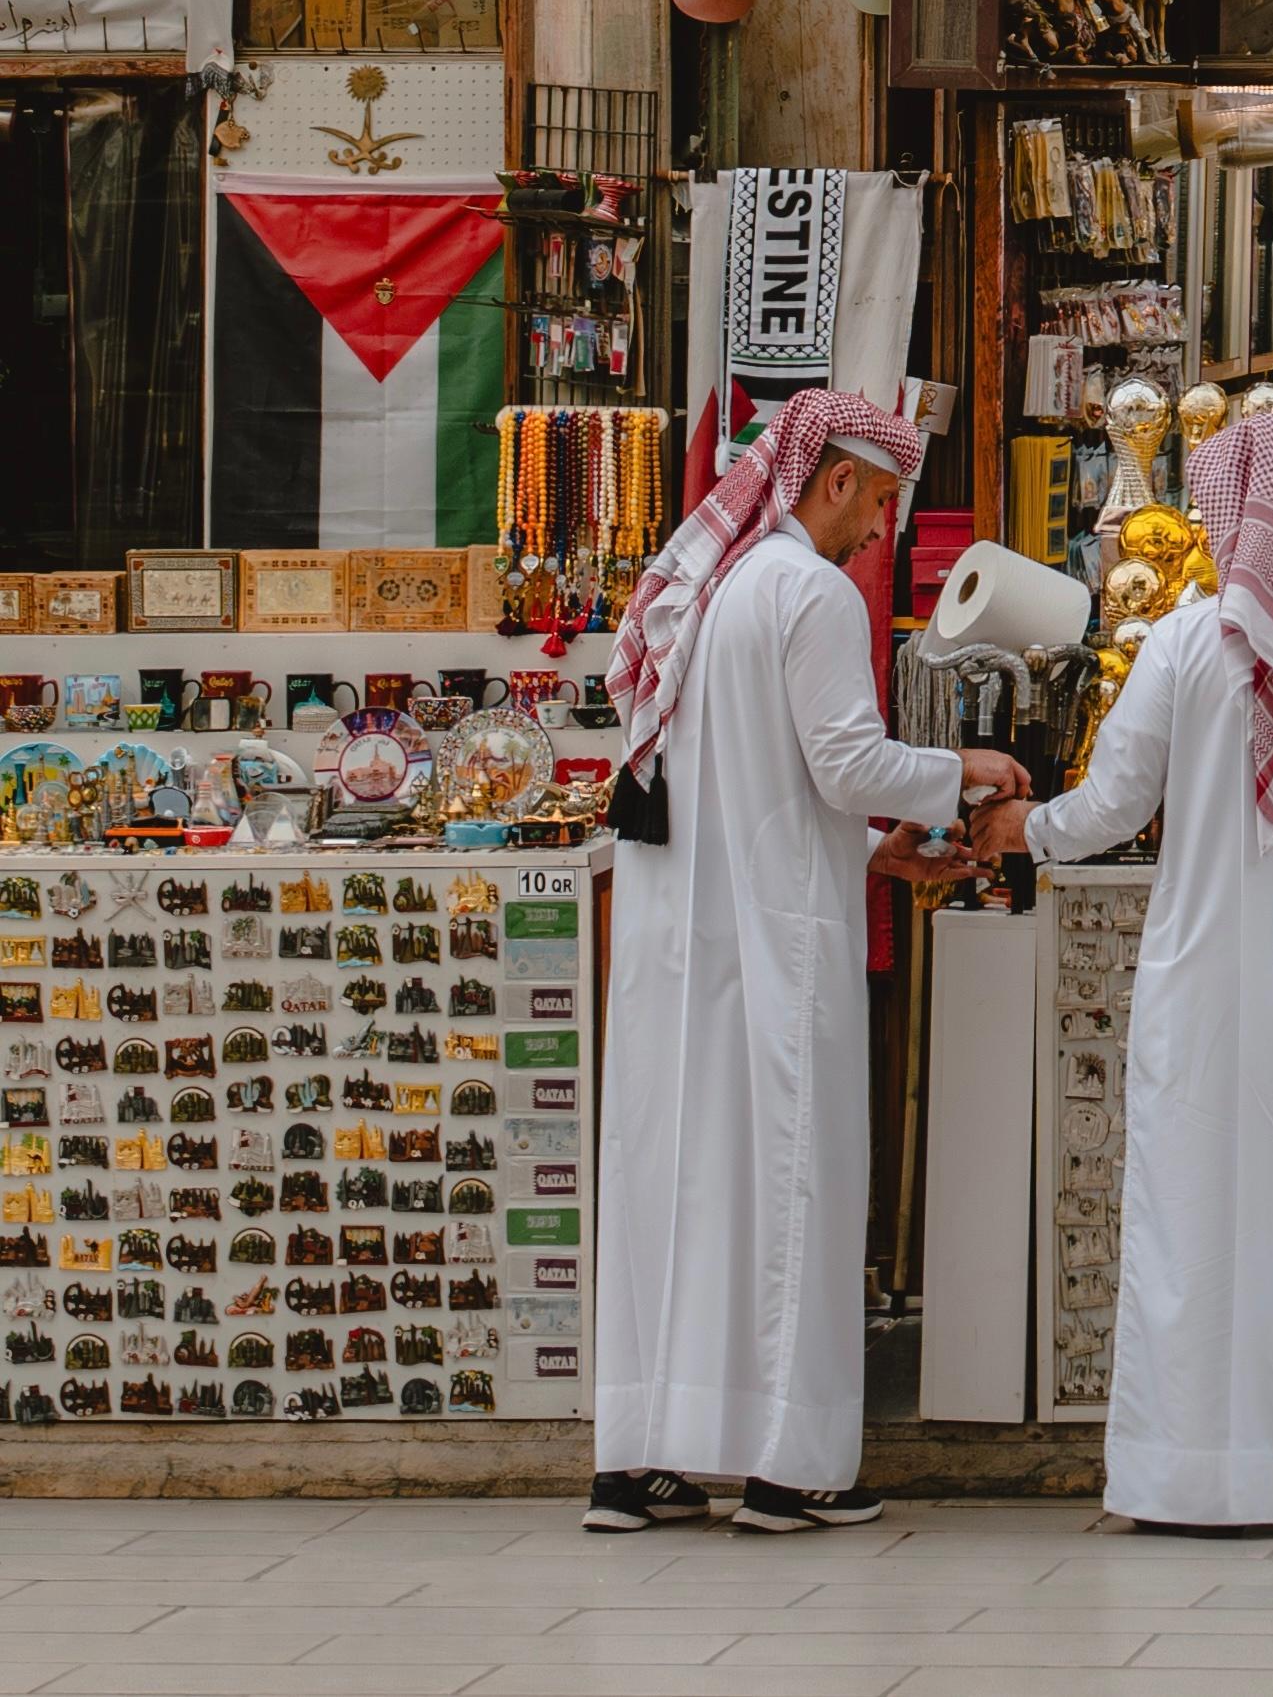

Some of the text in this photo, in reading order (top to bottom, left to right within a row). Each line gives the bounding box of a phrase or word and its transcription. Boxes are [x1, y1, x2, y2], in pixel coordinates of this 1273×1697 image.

[521, 871, 573, 894] 10 QR
[281, 999, 328, 1013] QATAR
[533, 996, 572, 1012] QATAR
[535, 1087, 575, 1103] QATAR
[537, 1173, 576, 1189] QATAR
[537, 1267, 577, 1282] QATAR
[538, 1355, 577, 1370] QATAR
